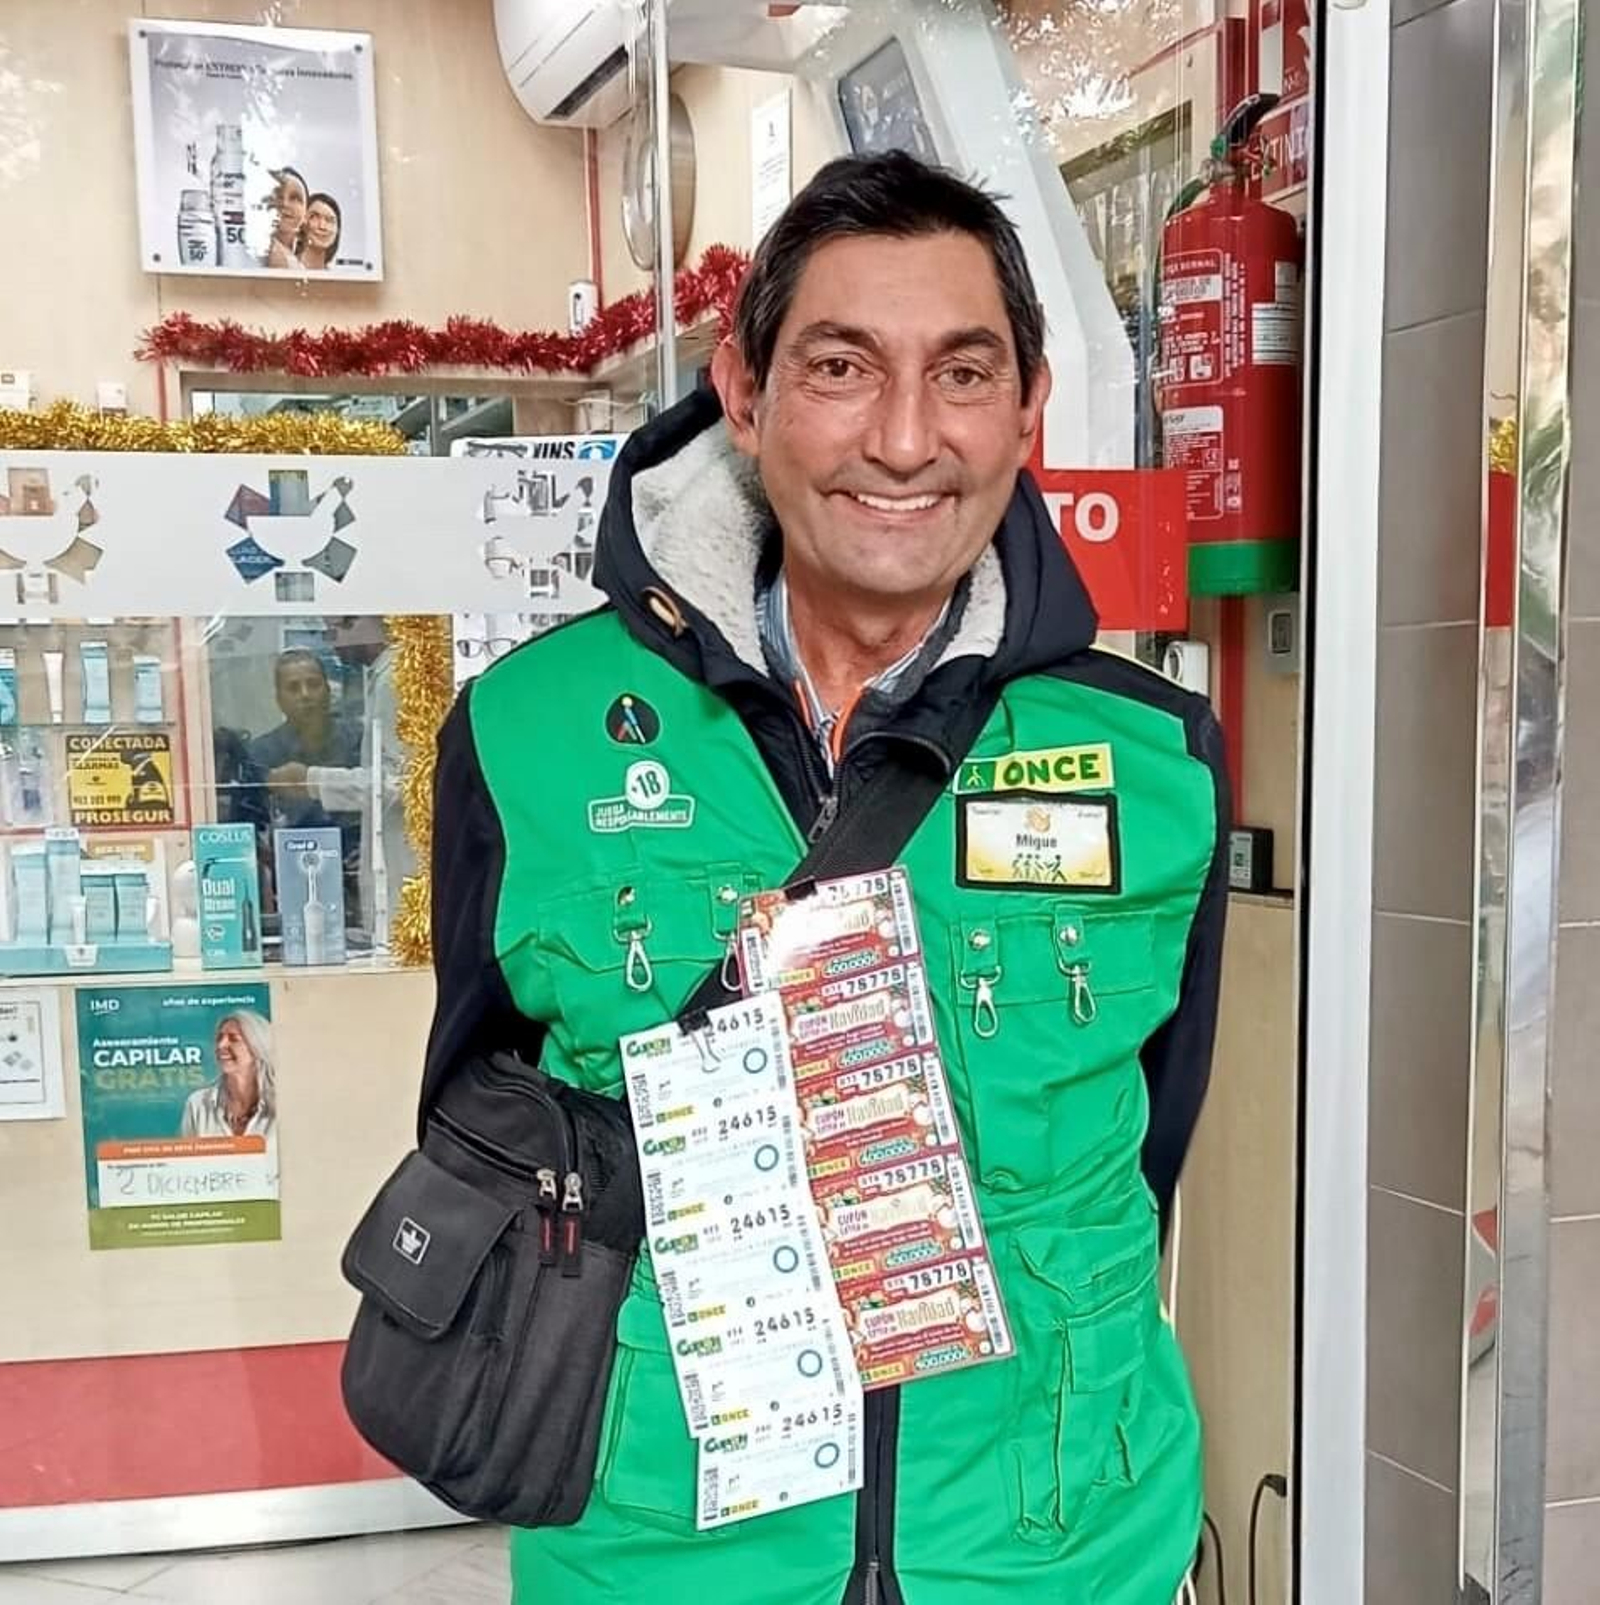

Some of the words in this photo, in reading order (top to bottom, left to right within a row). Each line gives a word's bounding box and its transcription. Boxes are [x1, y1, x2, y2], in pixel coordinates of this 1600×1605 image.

[1002, 753, 1101, 786] ONCE
[75, 810, 171, 824] PROSEGUR
[1015, 833, 1057, 850] Migue
[202, 878, 235, 895] Dual
[90, 999, 120, 1012] IMD
[93, 1047, 201, 1067] CAPILAR
[95, 1066, 204, 1090] GRATIS
[719, 1105, 777, 1135] 24615
[731, 1203, 790, 1234] 24615
[754, 1306, 815, 1337] 24615
[782, 1403, 842, 1432] 24615
